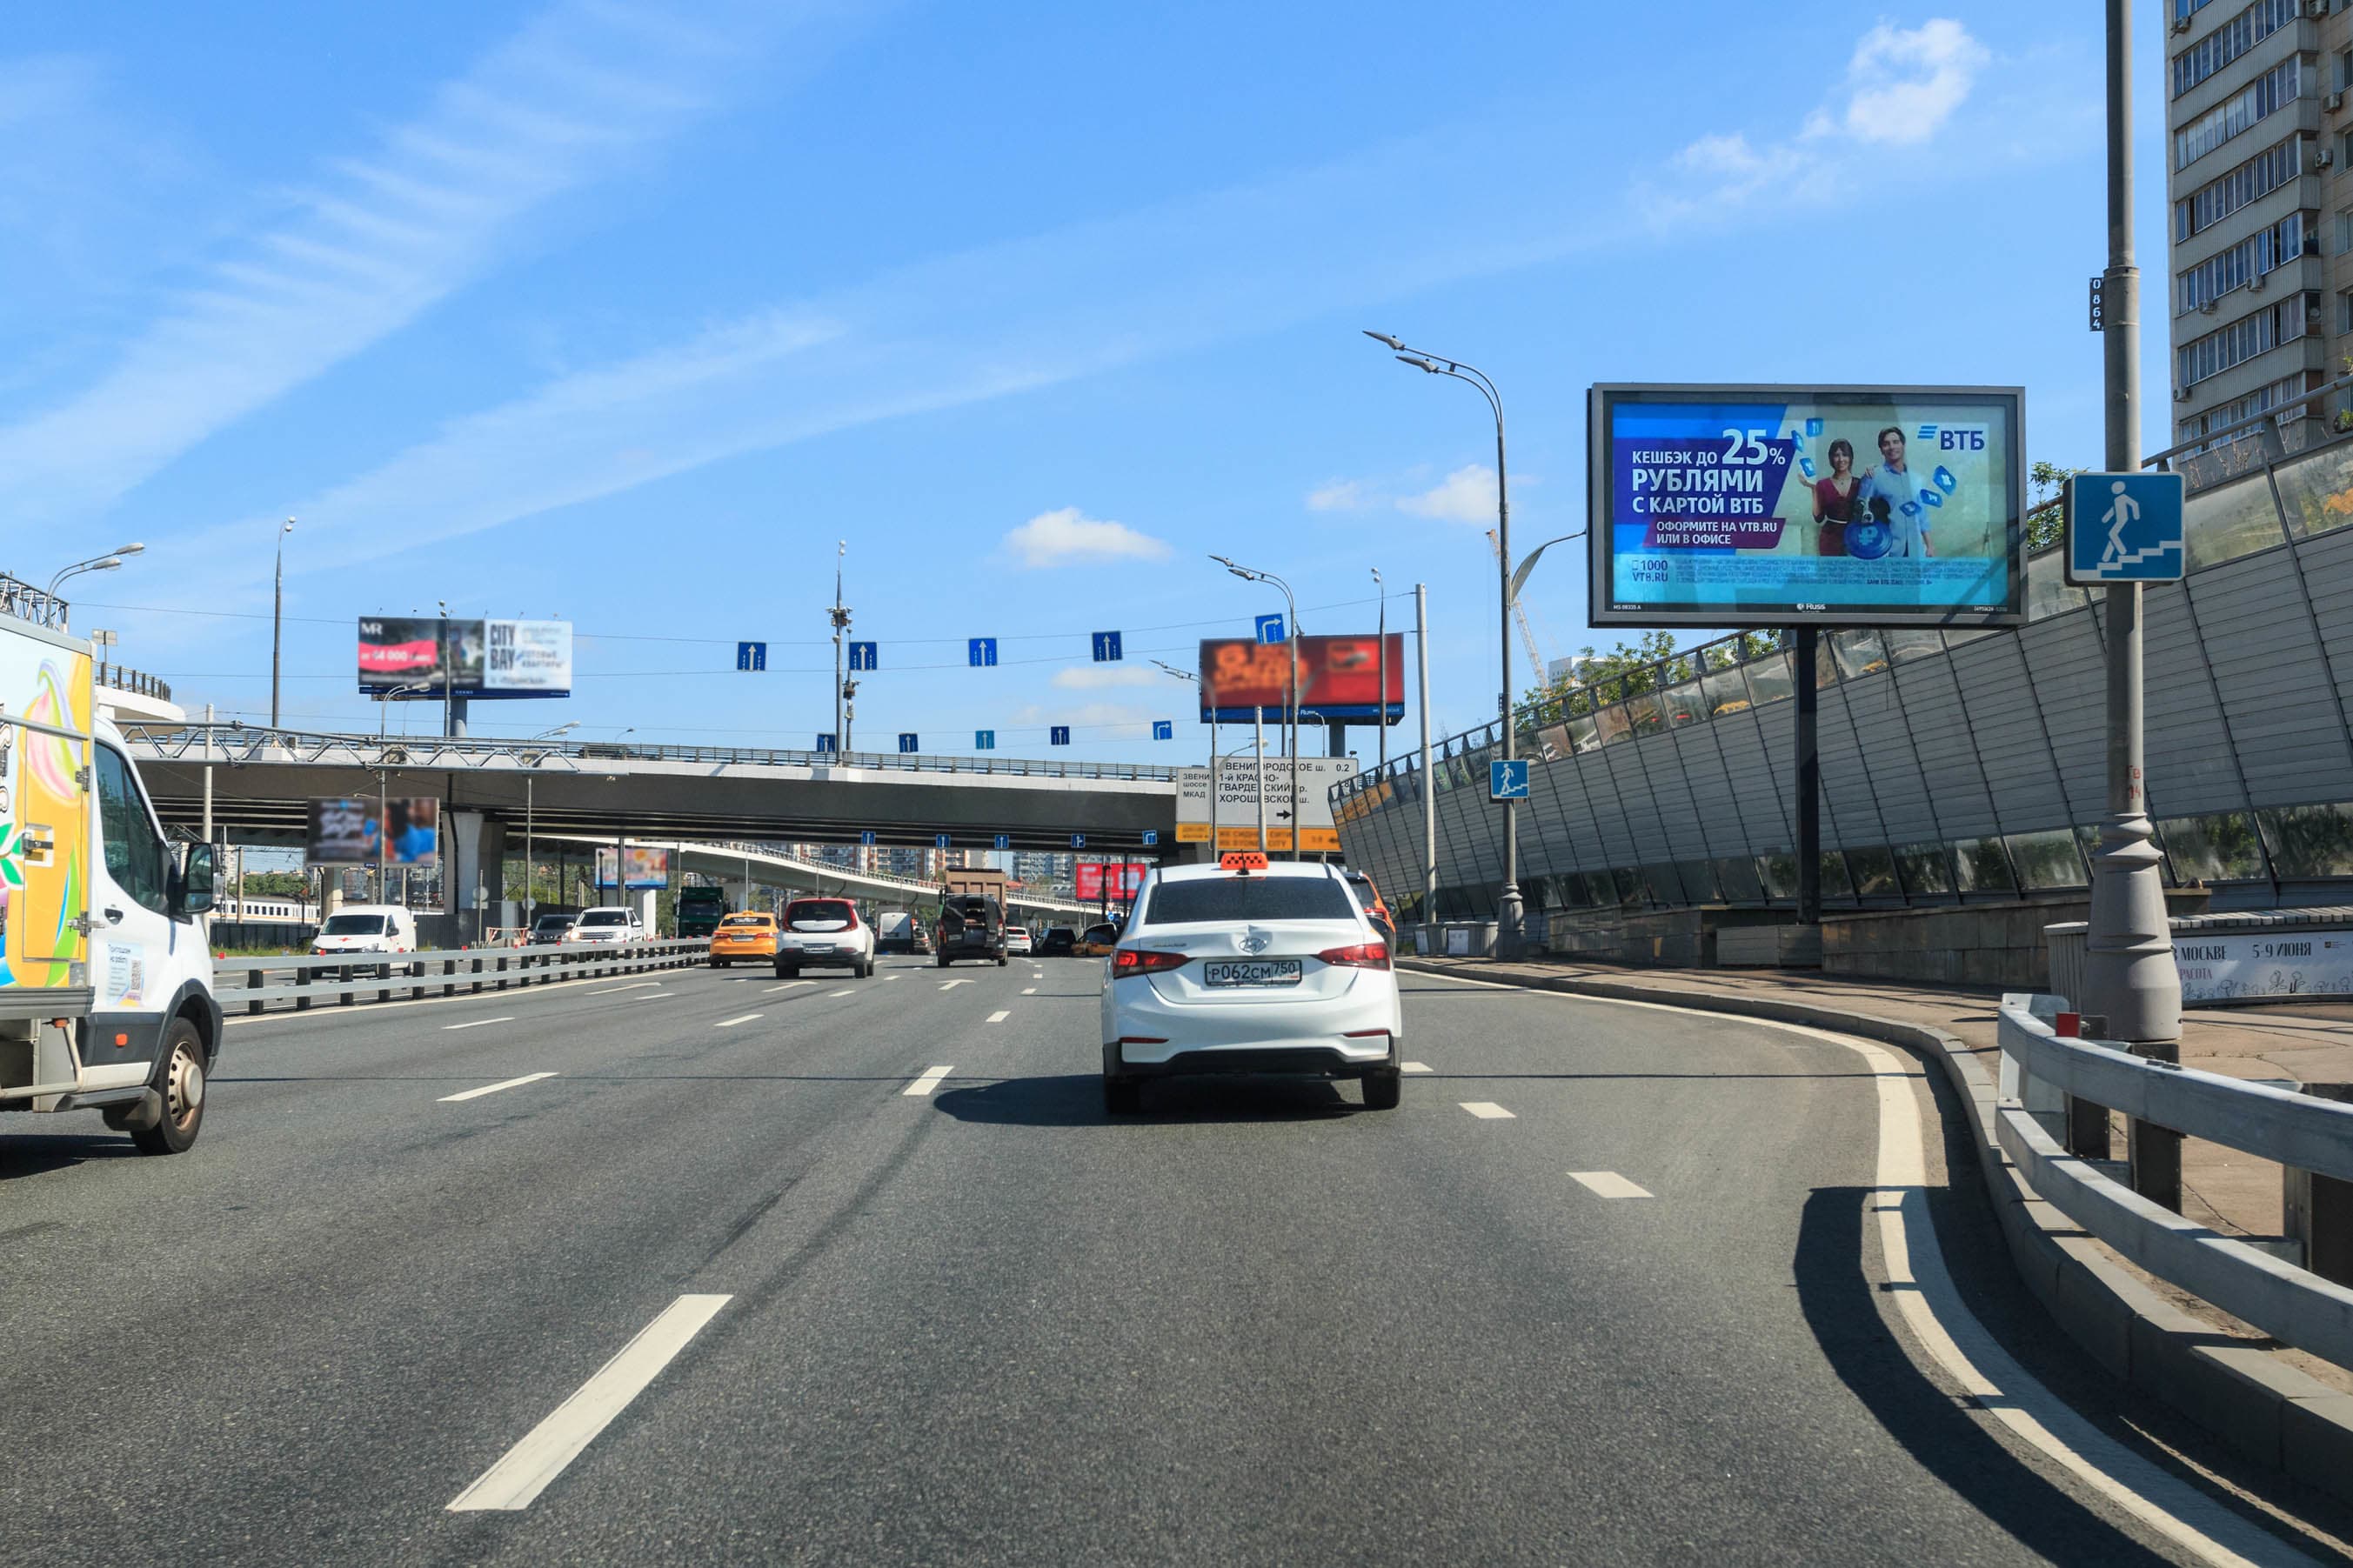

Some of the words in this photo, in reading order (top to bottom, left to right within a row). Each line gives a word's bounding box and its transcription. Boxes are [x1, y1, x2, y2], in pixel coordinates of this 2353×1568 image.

[1941, 430, 1985, 450] ВТБ
[1632, 451, 1693, 464] КЕШБЭК
[1696, 451, 1718, 466] ДО
[1721, 429, 1786, 465] 25%
[1632, 469, 1763, 492] РУБЛЯМИ
[1632, 497, 1644, 513] С
[1650, 494, 1725, 514] КАРТОЙ
[1730, 497, 1764, 514] ВТБ
[1656, 522, 1718, 532] ОФОРМИТЕ
[1721, 522, 1736, 532] НА
[1740, 522, 1777, 533] VTB.RU
[1656, 534, 1680, 544] ИЛИ
[1683, 534, 1689, 544] В
[1692, 534, 1731, 544] ОФИСЕ
[1641, 560, 1668, 571] 1000
[1633, 572, 1668, 583] VTB.RU
[490, 624, 515, 646] CITY
[490, 648, 515, 671] BAY
[1222, 762, 1313, 772] ВЕНИГРОДСОЕ
[1336, 764, 1350, 772] 0.2
[1220, 772, 1233, 782] 1-й
[1219, 783, 1291, 792] ГВАРДЕСКИЙ
[1219, 794, 1293, 804] ХОРОШВСКО
[2181, 944, 2228, 962] МОСКВЕ
[2252, 944, 2273, 958] 5-9
[2276, 942, 2311, 957] ИЮНЯ
[1273, 962, 1296, 975] 750
[2178, 967, 2213, 981] РАСОТА
